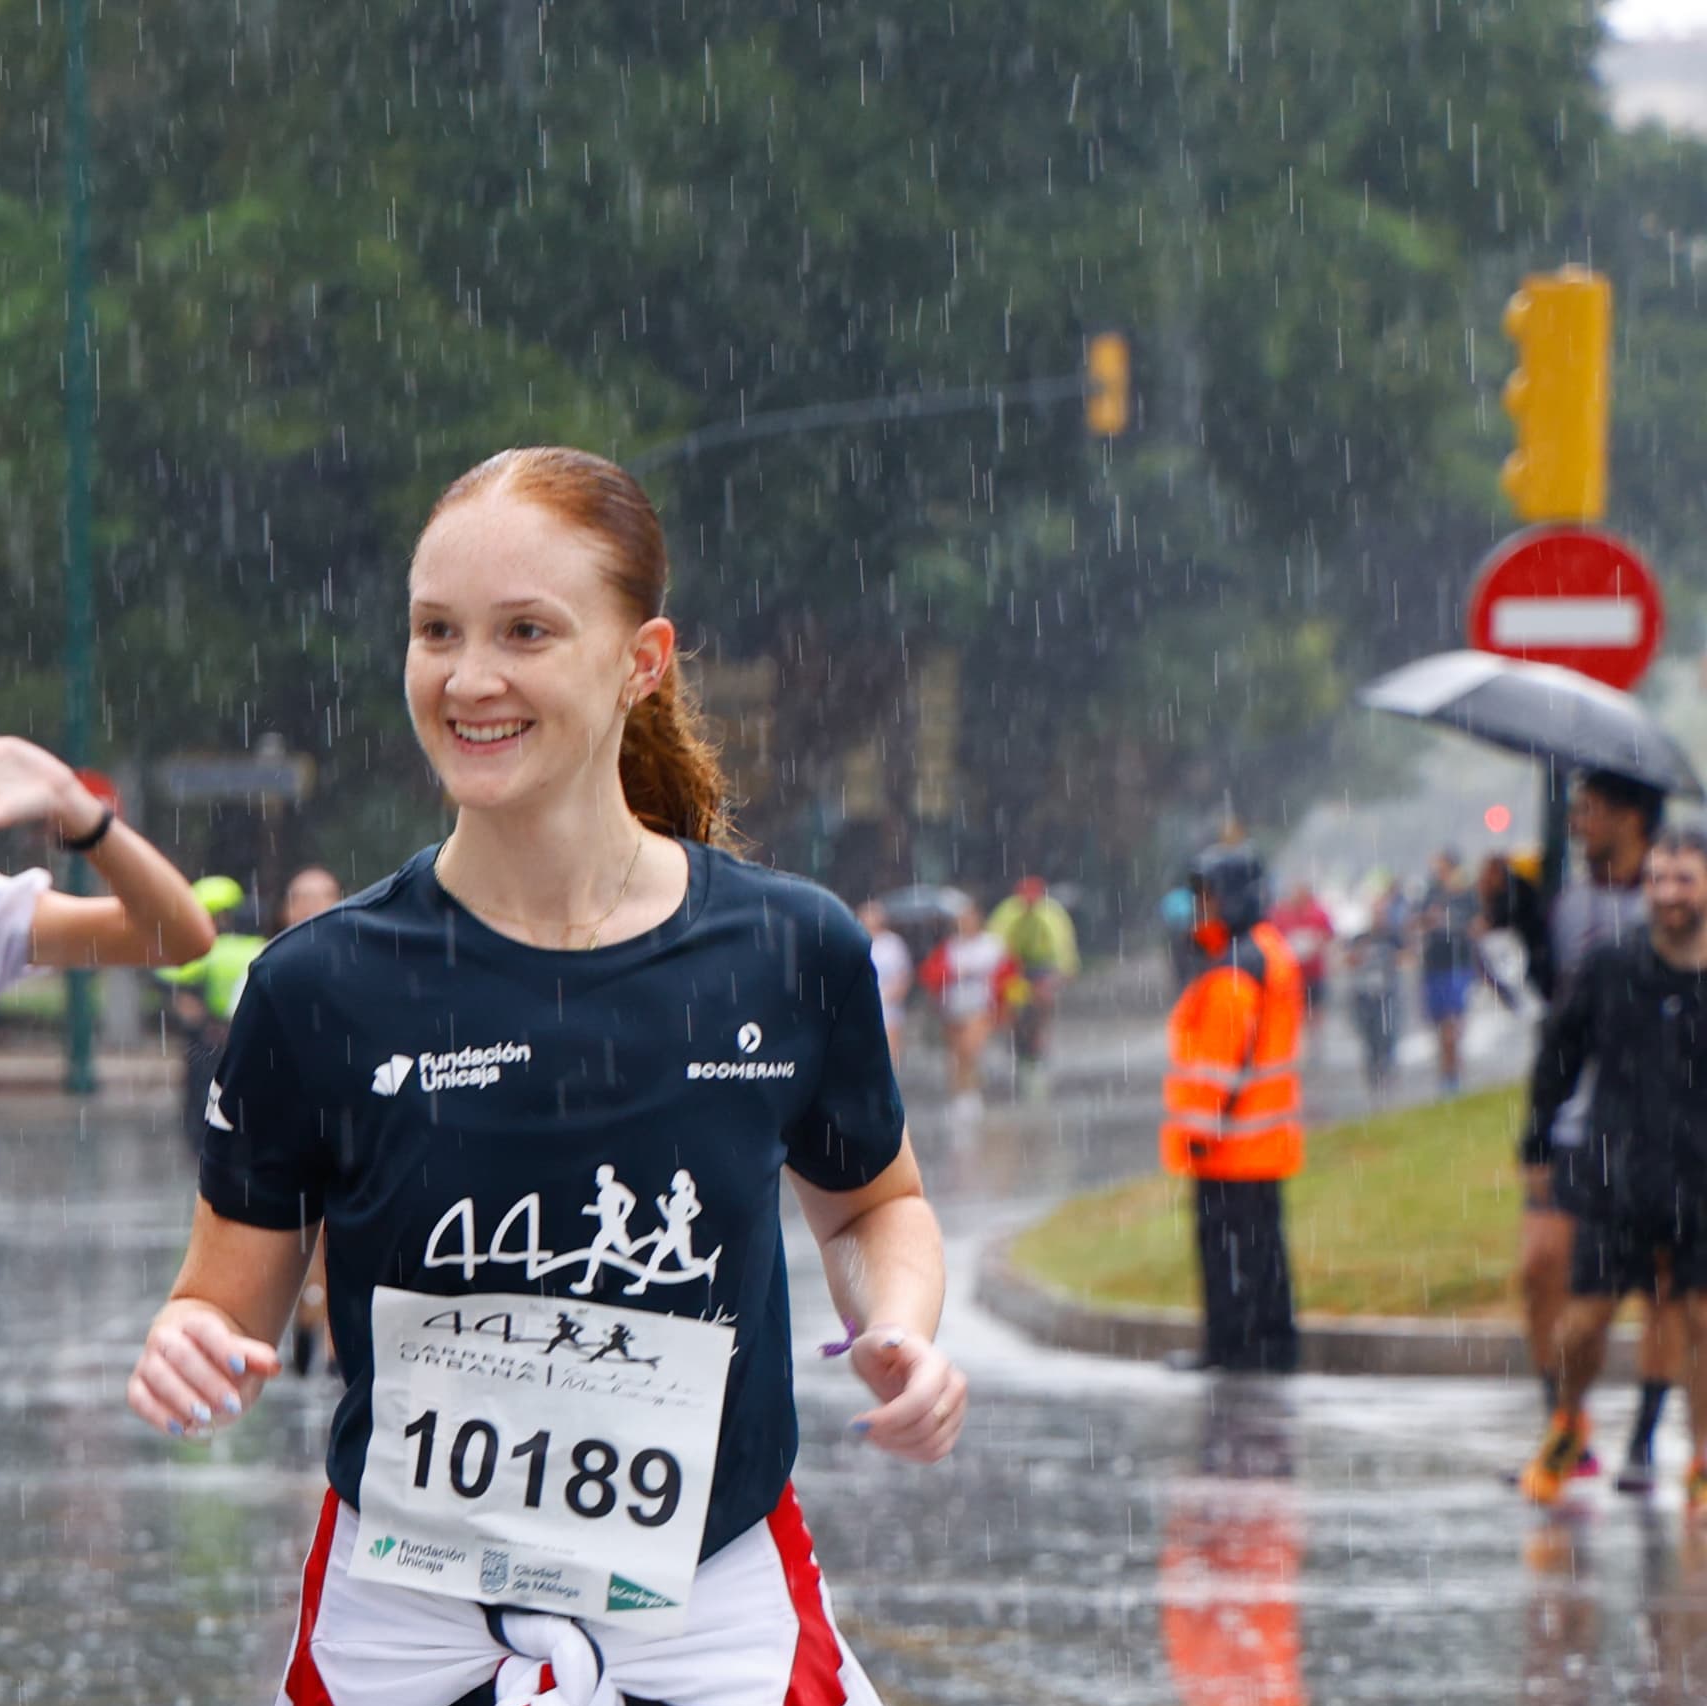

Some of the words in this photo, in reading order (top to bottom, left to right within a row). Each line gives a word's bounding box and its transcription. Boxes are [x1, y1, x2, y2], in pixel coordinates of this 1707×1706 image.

[418, 1040, 532, 1075] Fundación
[687, 1061, 796, 1080] BOOMERANG
[419, 1063, 501, 1093] Unicaja
[423, 1192, 554, 1281] 44
[422, 1309, 522, 1343] 44
[399, 1341, 537, 1371] CARRERA
[400, 1350, 536, 1384] URBANA
[404, 1410, 683, 1528] 10189
[397, 1554, 444, 1575] Unicaja
[400, 1539, 467, 1563] Fundación
[512, 1563, 563, 1580] Ciudad
